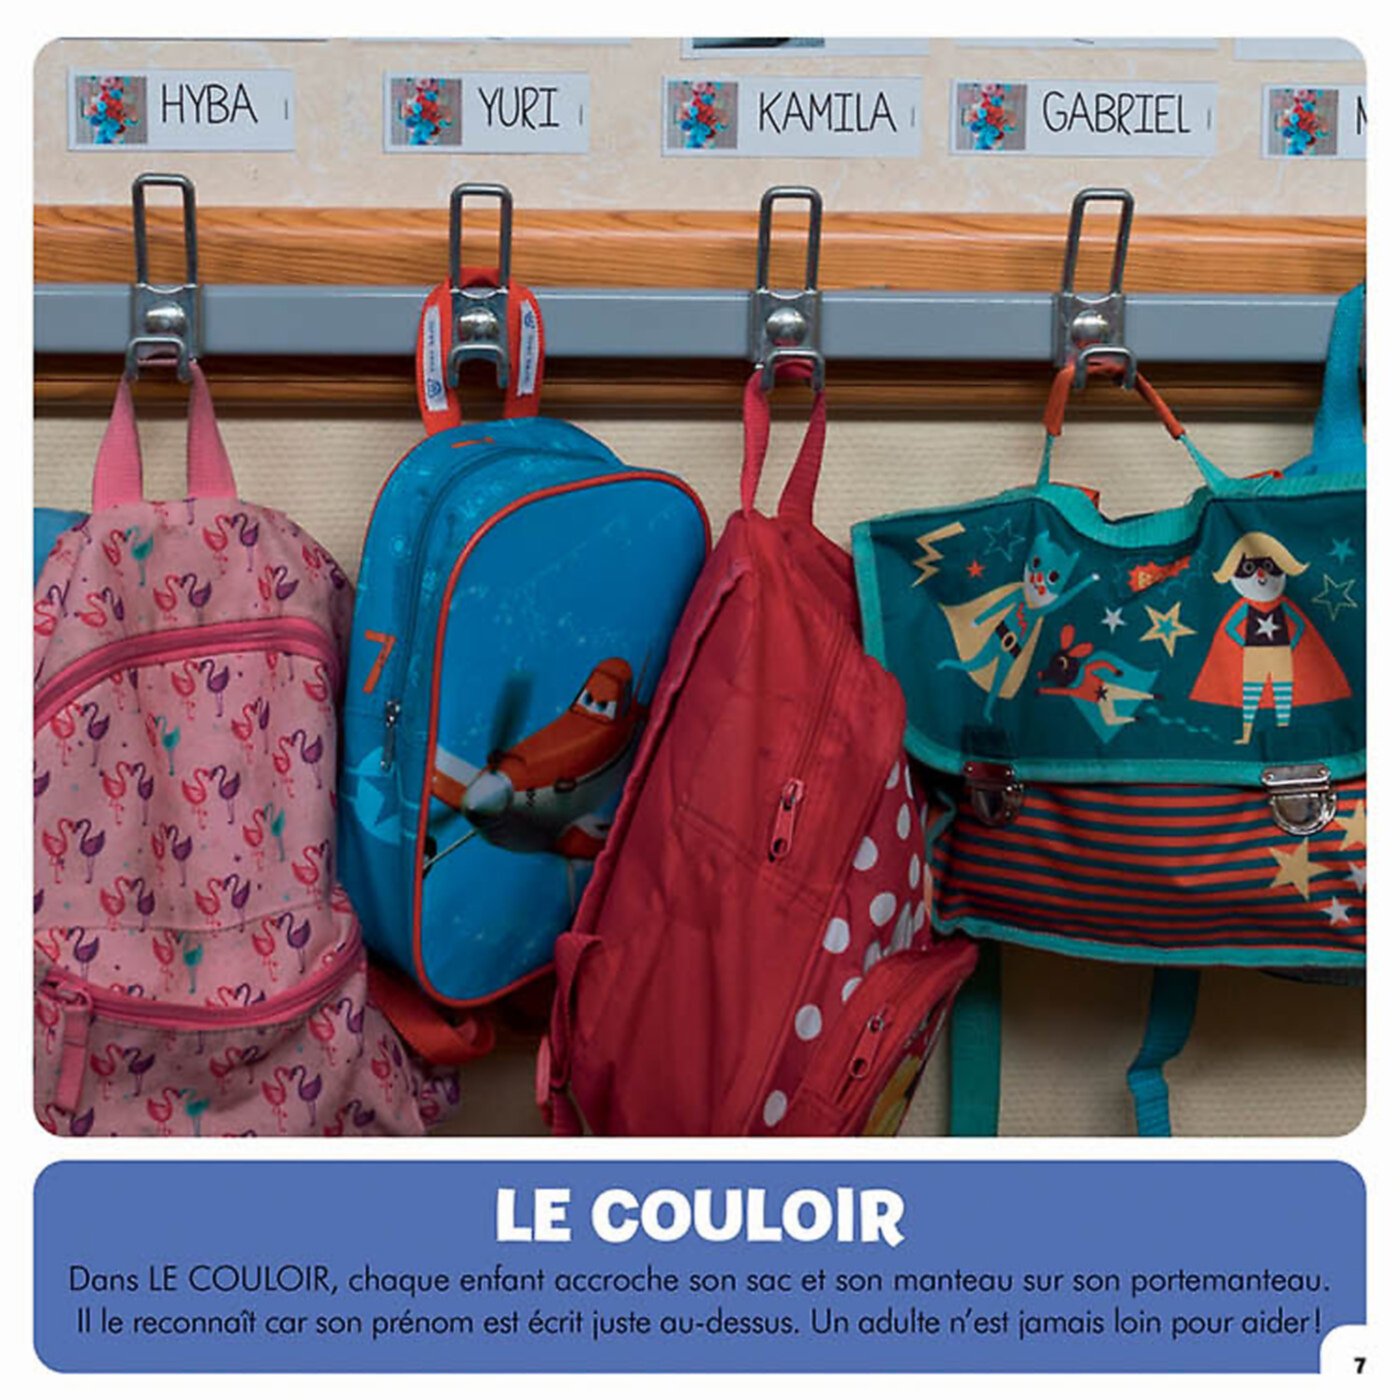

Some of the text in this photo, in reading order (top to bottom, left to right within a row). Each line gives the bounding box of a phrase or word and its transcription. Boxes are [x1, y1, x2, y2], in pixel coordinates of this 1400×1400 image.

[161, 83, 259, 124] HYBA
[477, 86, 560, 131] YURI
[759, 90, 898, 135] KAMILA
[1042, 90, 1191, 136] GABRIEL
[363, 630, 397, 694] 7
[497, 1187, 904, 1247] LE COULOIR
[70, 1264, 1329, 1298] Dans LE COULOIR, chaque enfant accroche son sac et son manteau sur son portemanteau.
[79, 1307, 90, 1333] Il
[102, 1307, 123, 1334] le
[134, 1309, 256, 1334] reconnaît
[265, 1317, 308, 1334] car
[316, 1317, 361, 1334] son
[373, 1309, 473, 1340] prénom
[484, 1311, 518, 1334] est
[528, 1309, 583, 1334] écrit
[594, 1310, 650, 1340] juste
[660, 1307, 799, 1334] au-dessus.
[812, 1308, 848, 1334] Un
[859, 1307, 940, 1334] adulte
[951, 1308, 1008, 1334] n’est
[1020, 1310, 1104, 1340] jamais
[1115, 1306, 1161, 1334] loin
[1172, 1317, 1234, 1340] pour
[1353, 1357, 1367, 1375] 7
